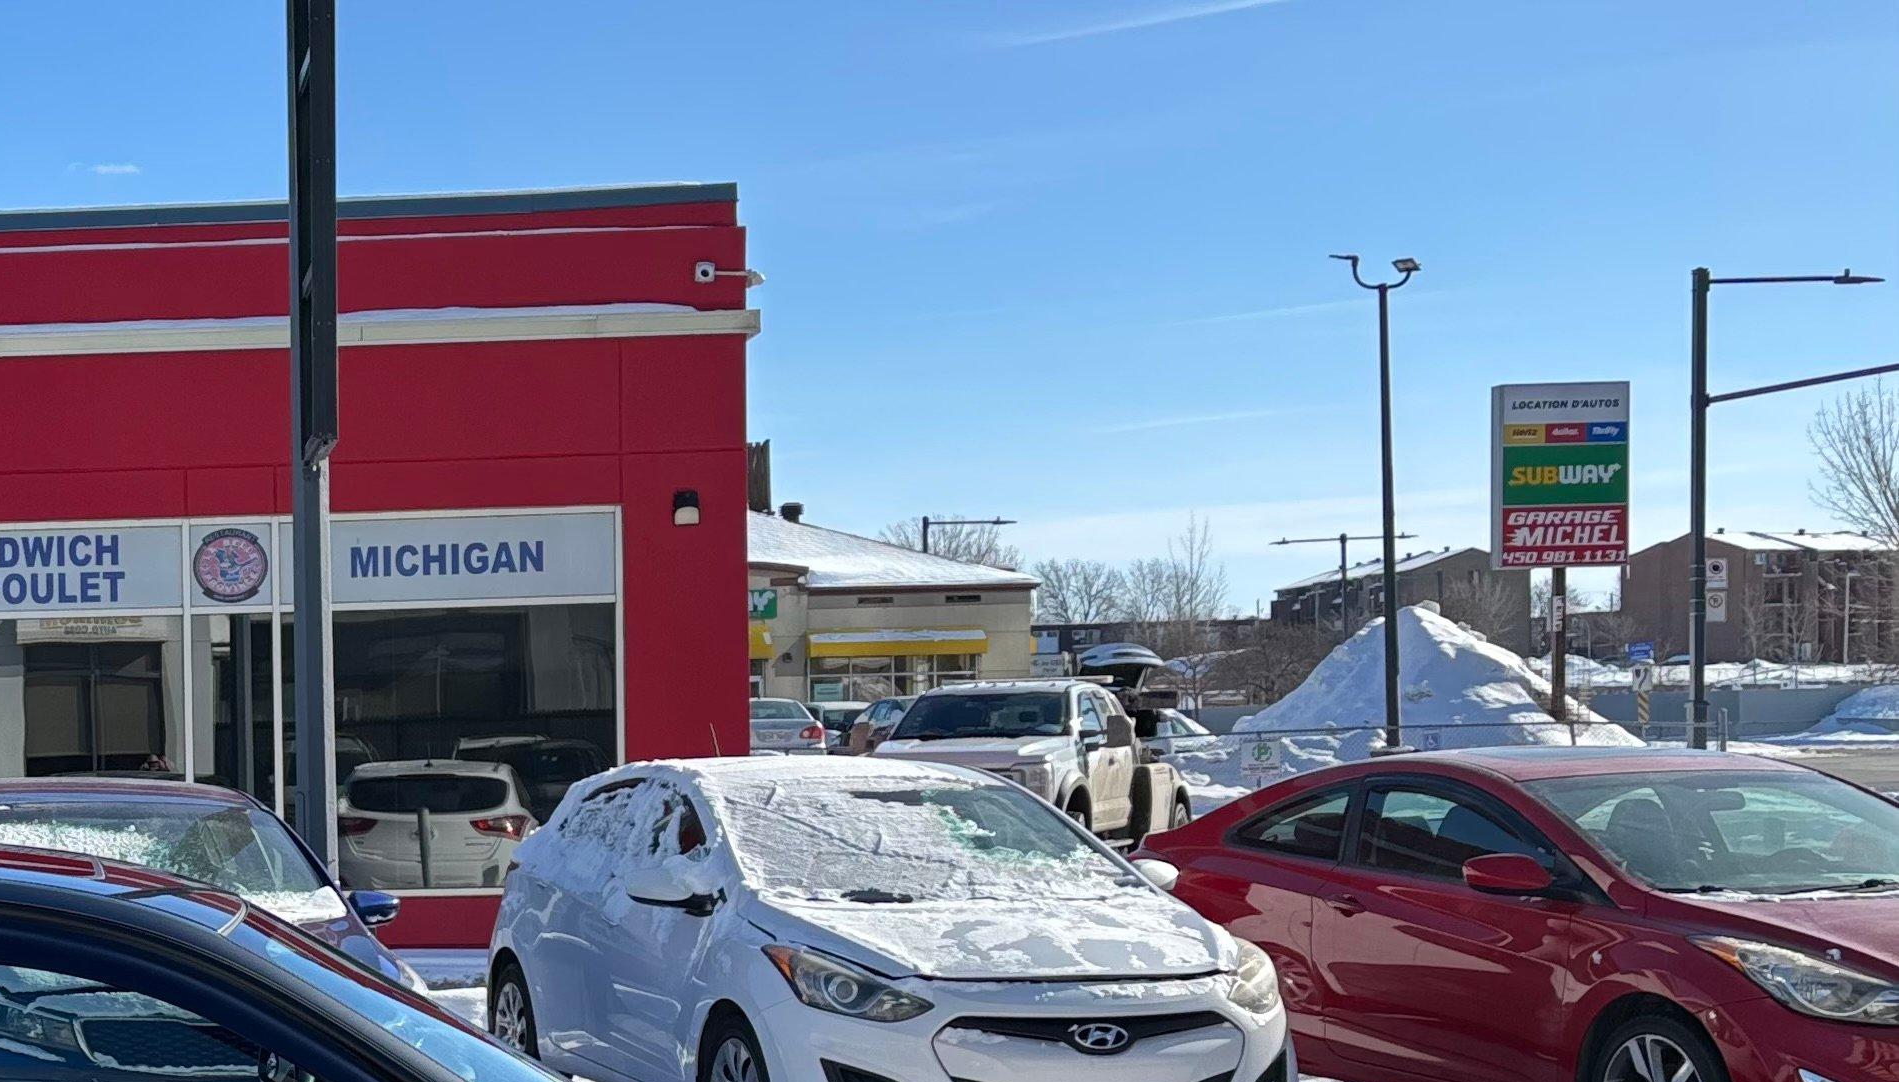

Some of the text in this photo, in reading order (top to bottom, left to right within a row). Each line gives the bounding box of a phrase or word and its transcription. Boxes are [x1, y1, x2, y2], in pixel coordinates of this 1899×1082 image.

[1512, 398, 1620, 410] LOCATION D'AUTOS
[1508, 463, 1622, 486] SUBWAY
[1506, 509, 1622, 526] GARAGE
[1512, 525, 1625, 546] MICHEL
[350, 540, 544, 578] MICHIGAN
[1502, 549, 1627, 564] 450.981.1131
